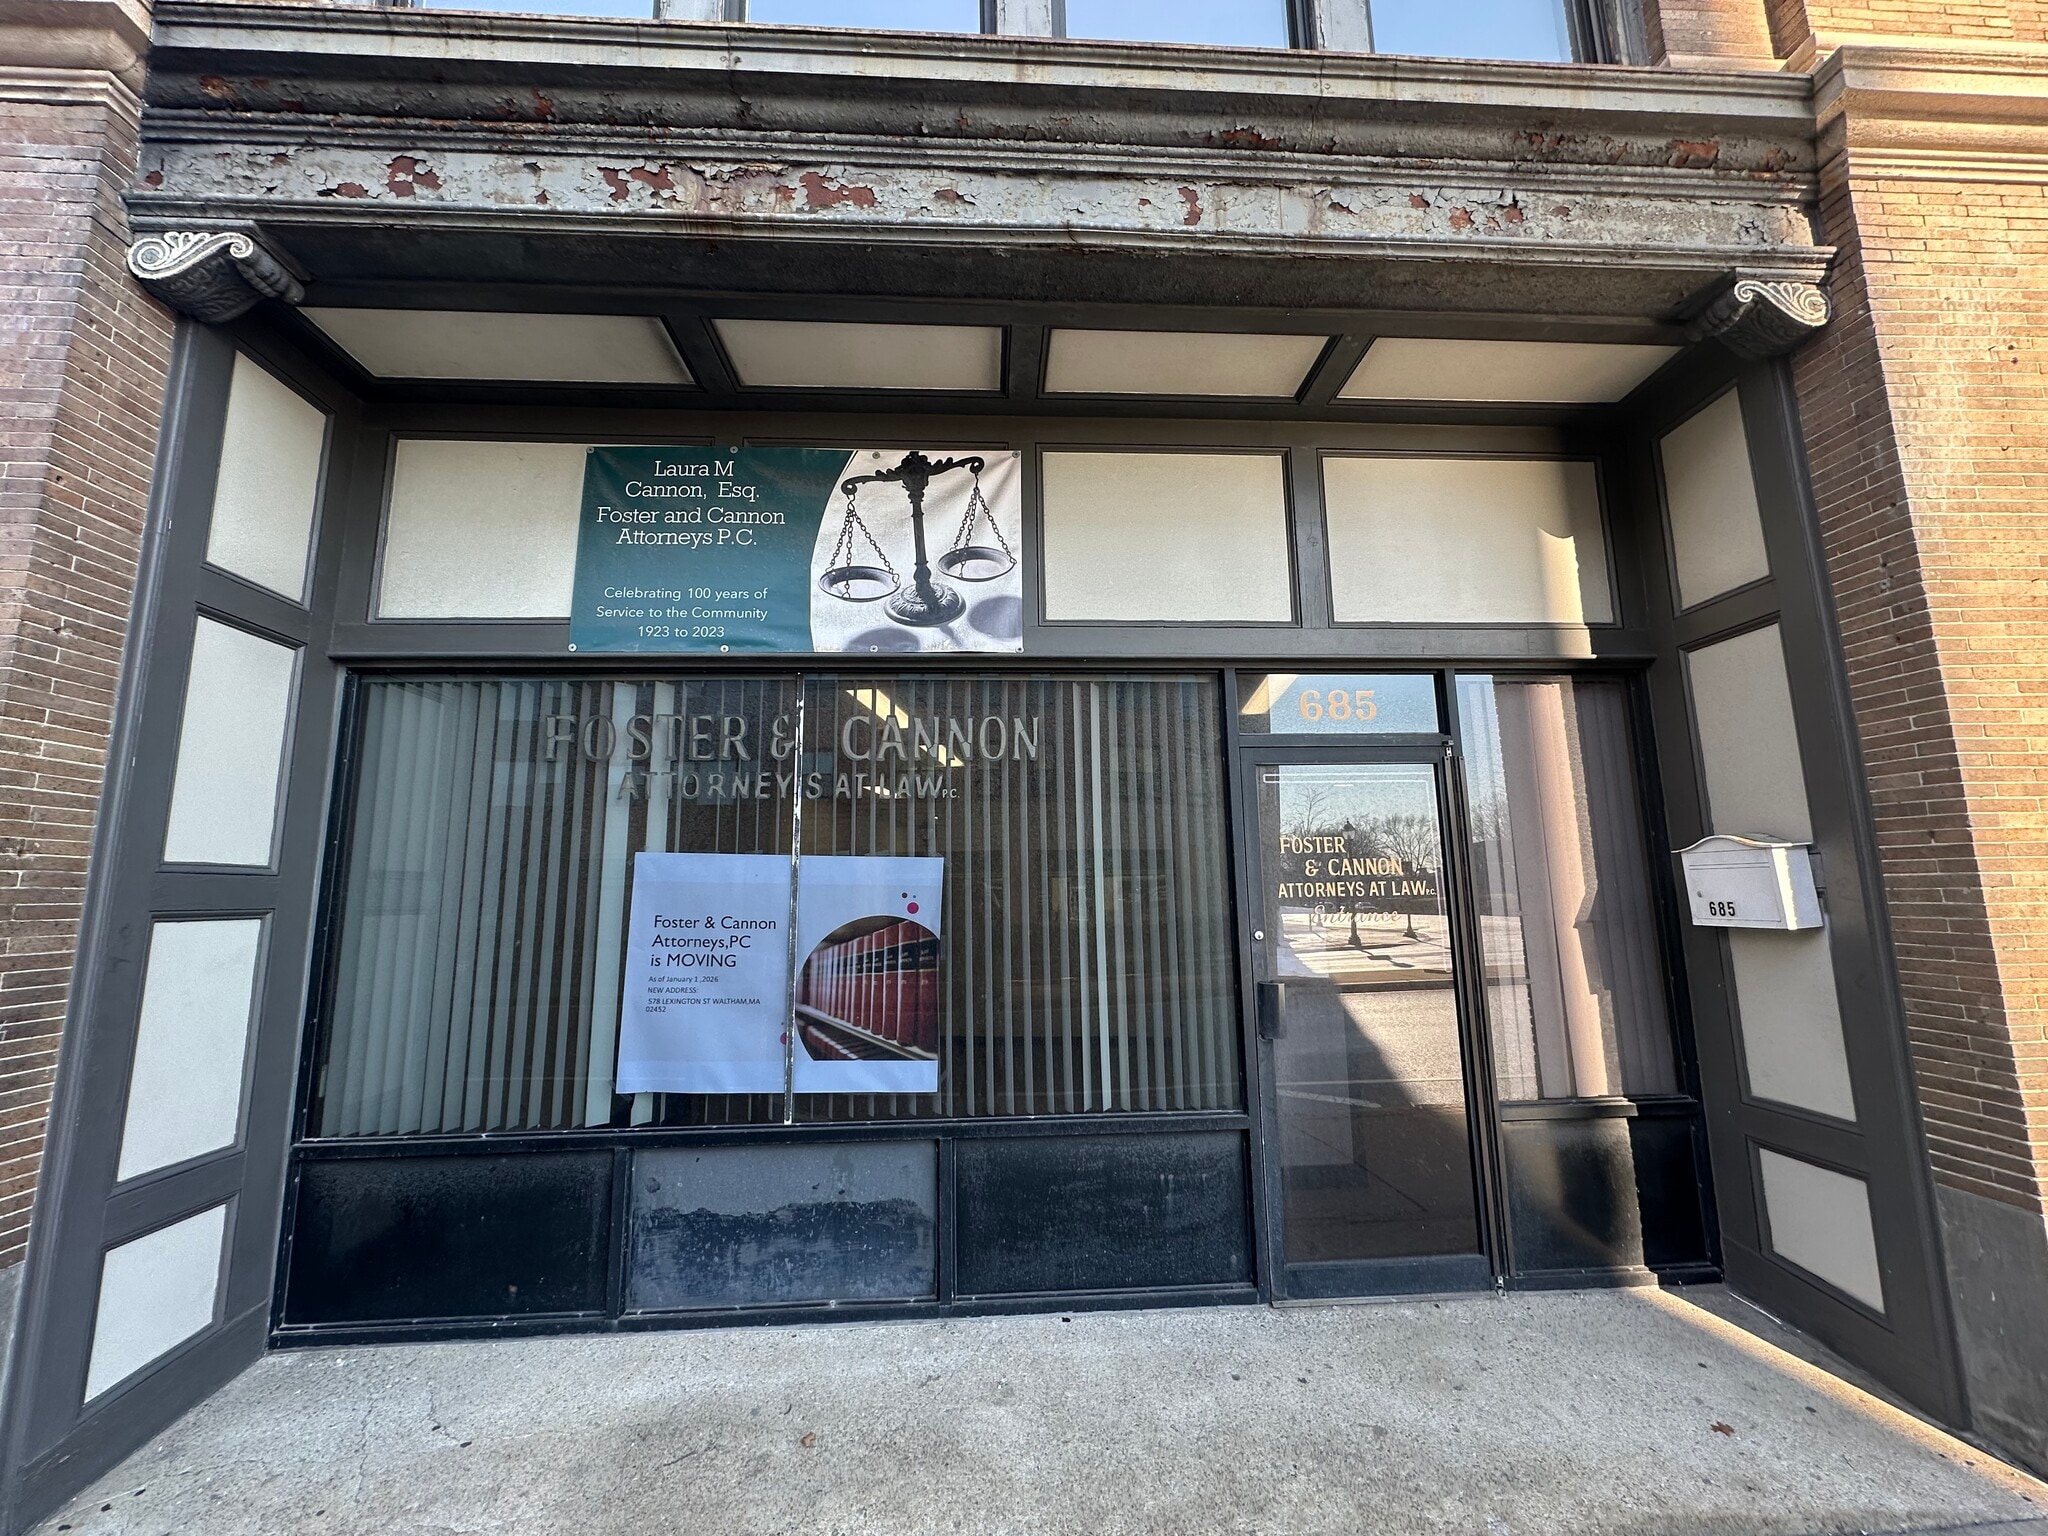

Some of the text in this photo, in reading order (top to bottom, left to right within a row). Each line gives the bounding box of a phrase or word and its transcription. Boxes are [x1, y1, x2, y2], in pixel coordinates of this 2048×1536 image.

[654, 460, 735, 477] Laura M
[625, 481, 760, 502] Cannon, Esq.
[596, 506, 786, 525] Foster and Cannon
[615, 528, 757, 549] Attorneys P.C.
[604, 587, 768, 601] Celebrating 100 years of
[596, 606, 768, 621] Service to the Community
[638, 626, 725, 638] 1923 to 2023
[1300, 689, 1377, 721] 685
[544, 713, 1039, 762] FOSTER & CANNON
[617, 771, 824, 800] ATTORNEYS
[834, 772, 869, 799] AT
[879, 772, 943, 799] LAW
[1279, 836, 1346, 854] FOSTER
[1304, 857, 1403, 876] & CANNON
[1278, 881, 1365, 899] ATTORNEYS
[1369, 881, 1387, 897] AT
[1392, 880, 1426, 896] LAW
[1312, 904, 1401, 924] Entrance
[1709, 901, 1736, 917] 685
[654, 915, 777, 930] Foster & Cannon
[650, 954, 737, 967] is MOVING
